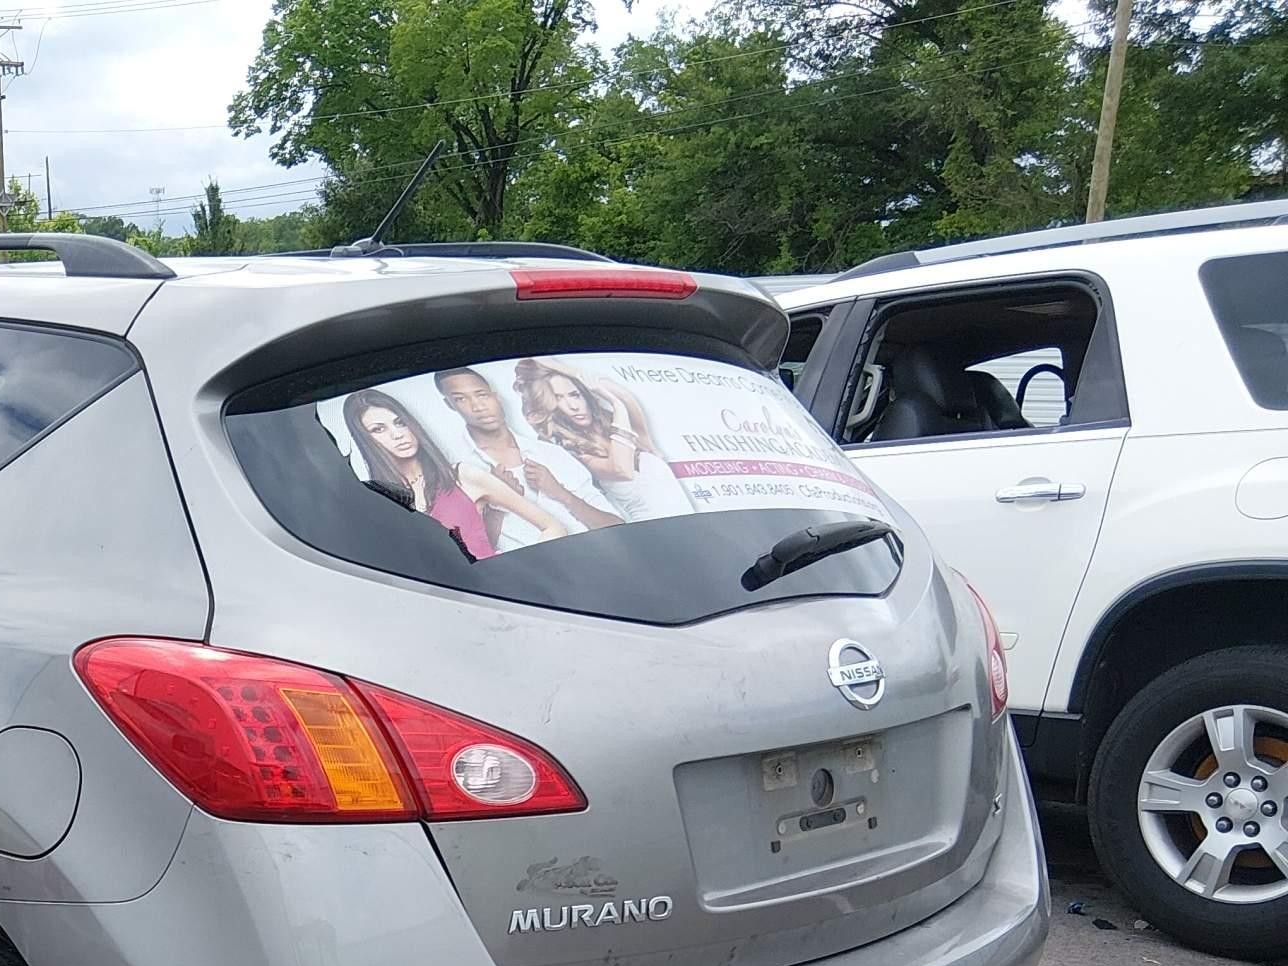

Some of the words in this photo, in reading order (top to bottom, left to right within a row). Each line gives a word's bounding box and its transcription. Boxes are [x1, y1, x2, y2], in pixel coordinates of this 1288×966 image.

[612, 365, 679, 385] Where
[675, 367, 742, 390] Dreams
[680, 433, 788, 455] FINISHING
[683, 460, 746, 477] MODELING
[507, 895, 673, 935] MURANO
